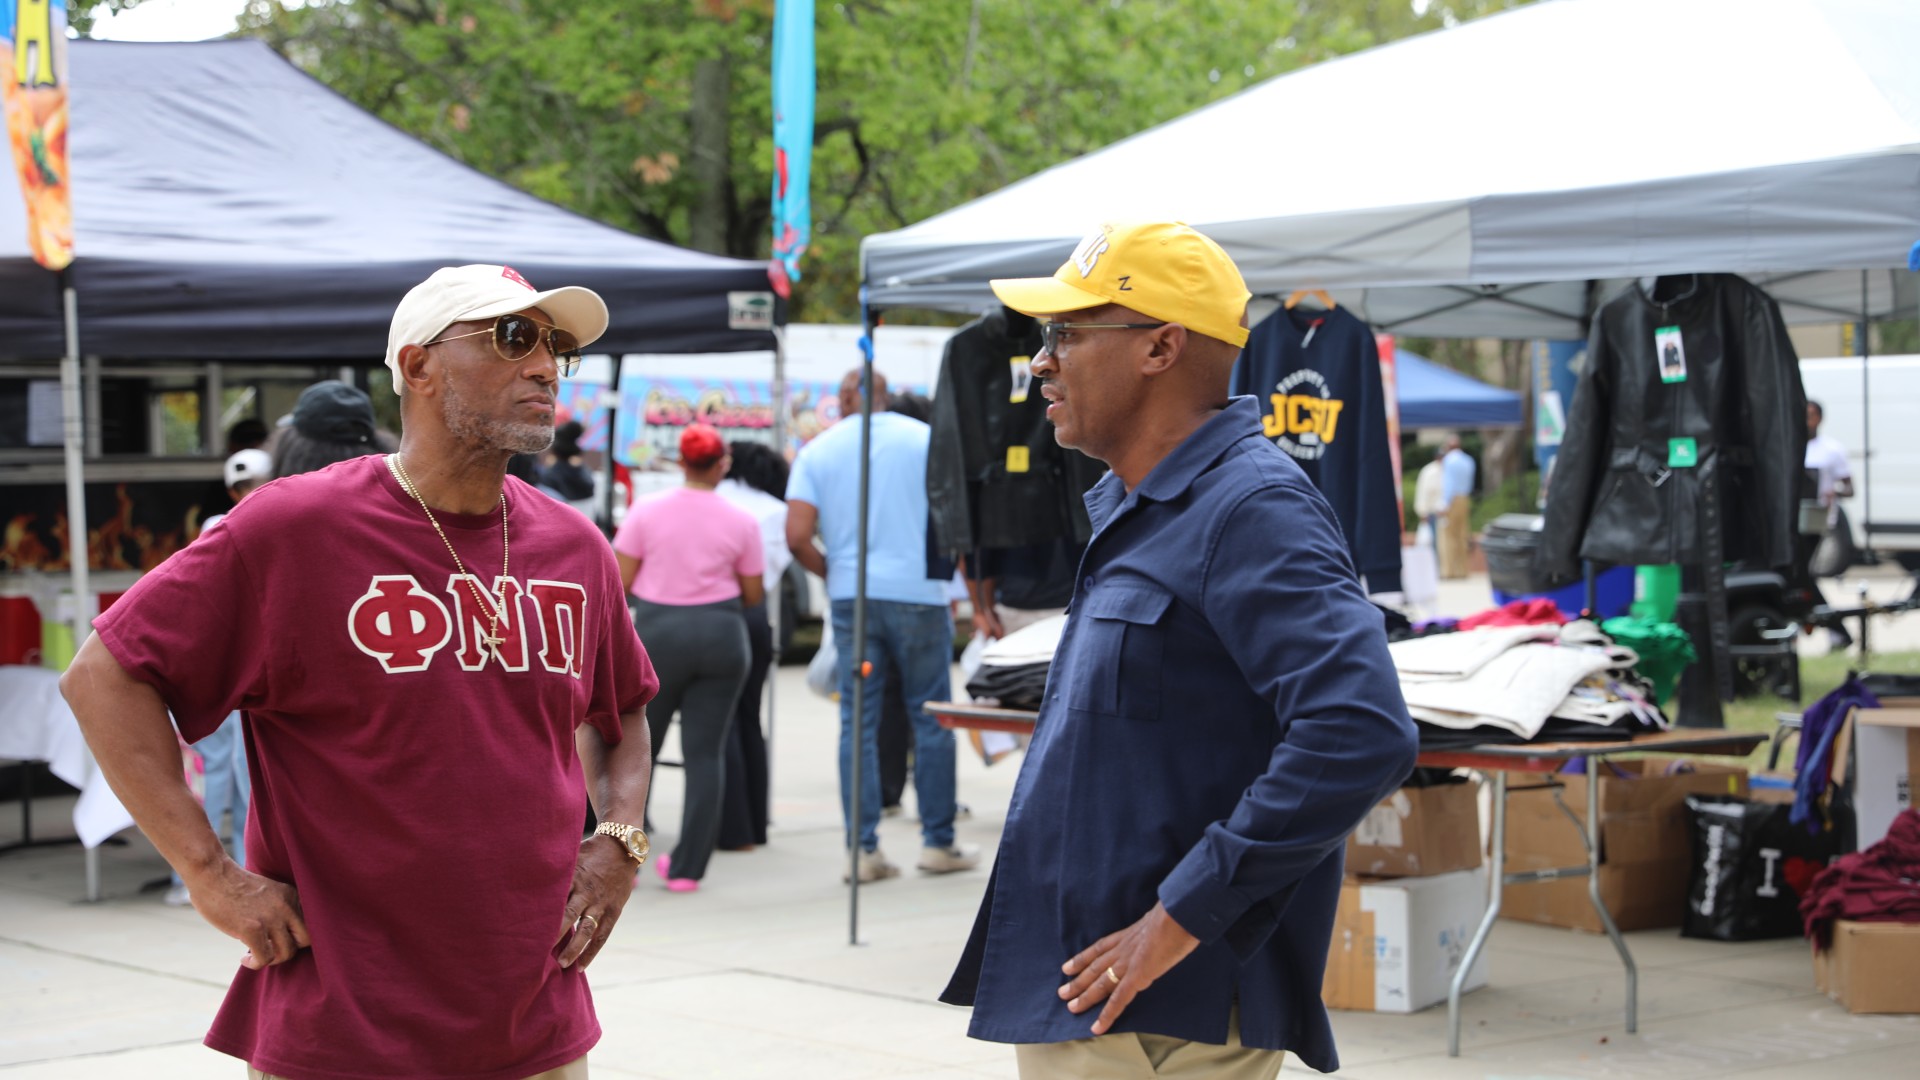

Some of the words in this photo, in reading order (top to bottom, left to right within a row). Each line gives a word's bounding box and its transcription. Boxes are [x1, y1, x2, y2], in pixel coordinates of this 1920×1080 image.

[1117, 275, 1133, 291] Z
[1261, 393, 1344, 444] JCSU
[1756, 848, 1781, 897] I
